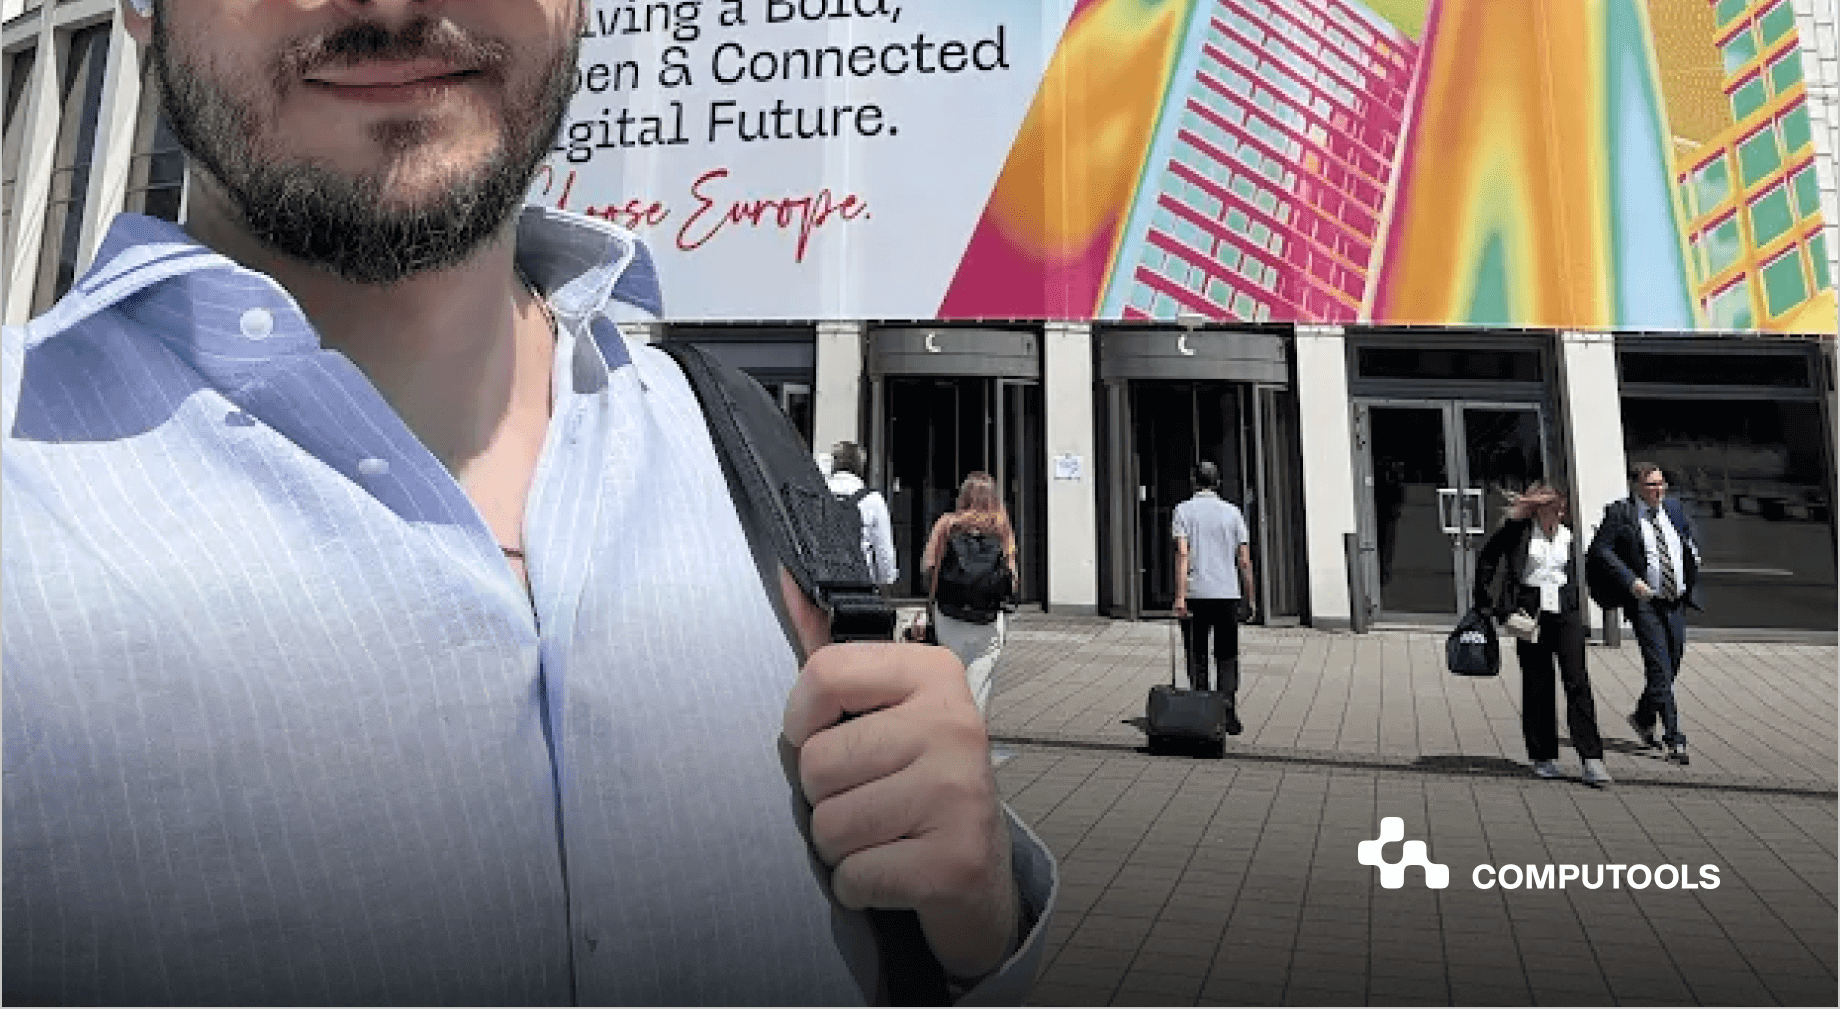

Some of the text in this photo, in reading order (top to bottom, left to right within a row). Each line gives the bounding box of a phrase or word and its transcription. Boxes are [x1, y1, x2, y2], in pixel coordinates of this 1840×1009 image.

[657, 46, 692, 88] &
[711, 24, 1010, 84] Connected
[554, 98, 898, 163] gital Future.
[676, 168, 871, 262] Europe.
